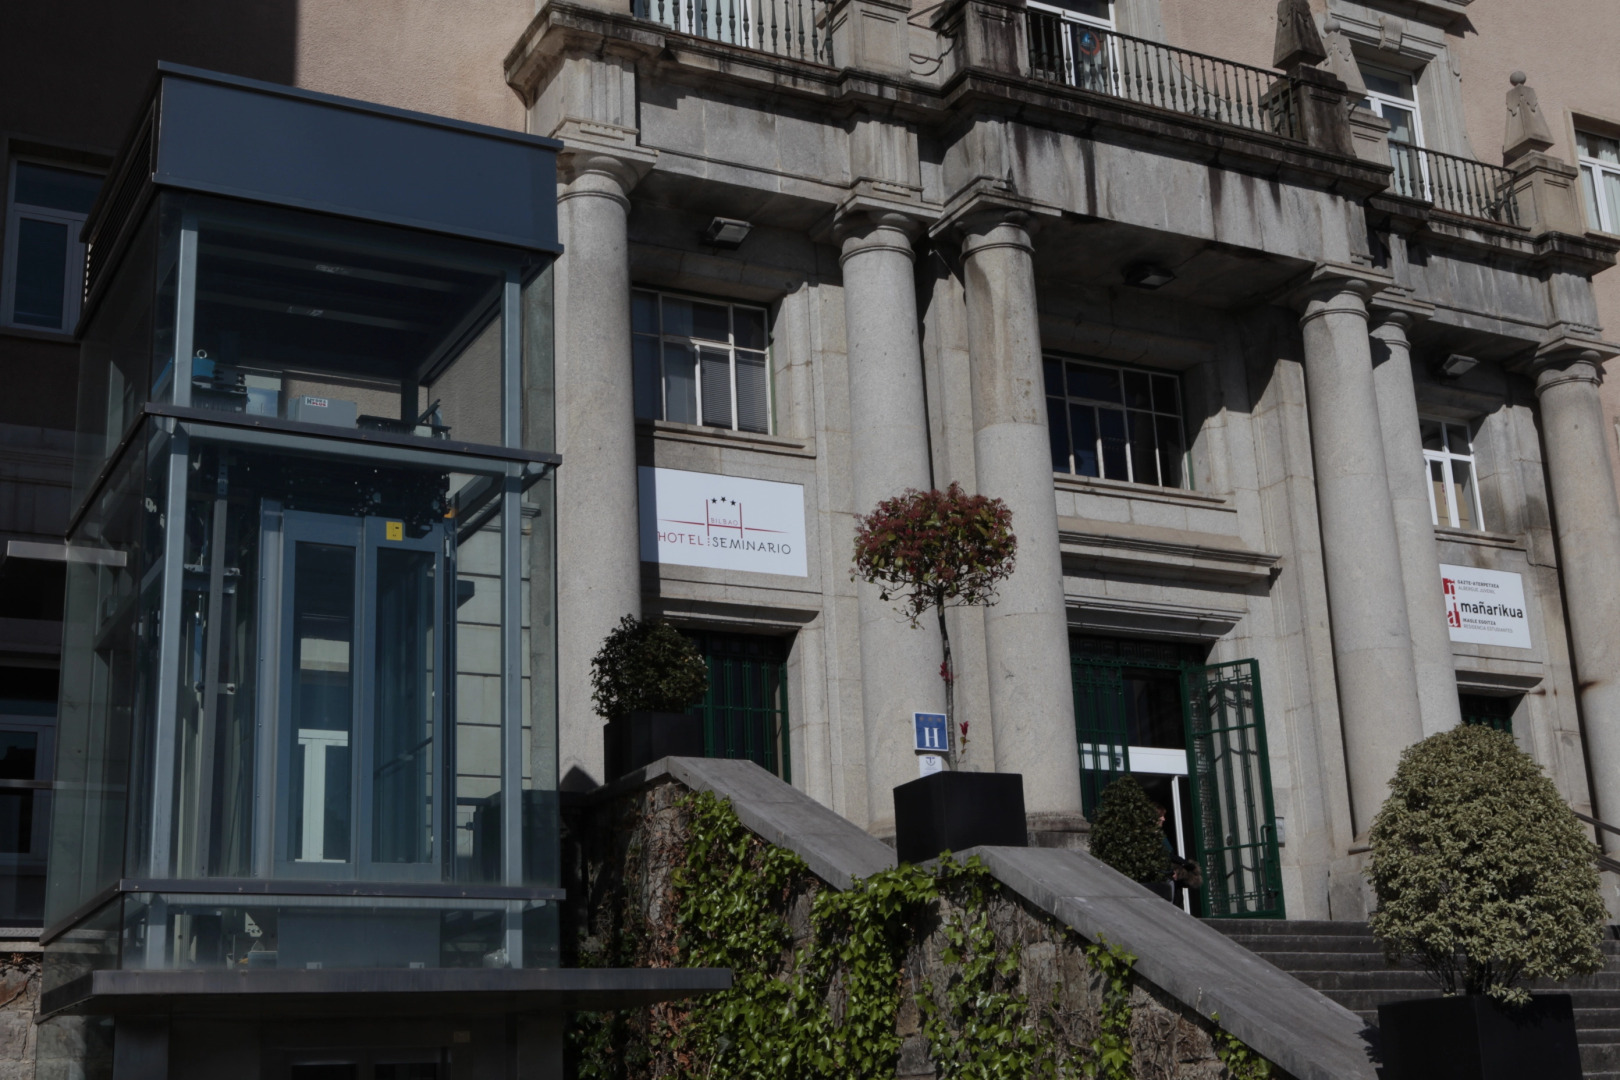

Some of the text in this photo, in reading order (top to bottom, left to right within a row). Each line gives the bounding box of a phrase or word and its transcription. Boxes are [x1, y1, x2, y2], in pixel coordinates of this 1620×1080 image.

[710, 517, 739, 525] BILBAO
[658, 531, 791, 555] HOTEL SEMINARIO
[1461, 601, 1523, 618] mañarikua
[924, 727, 939, 747] H
